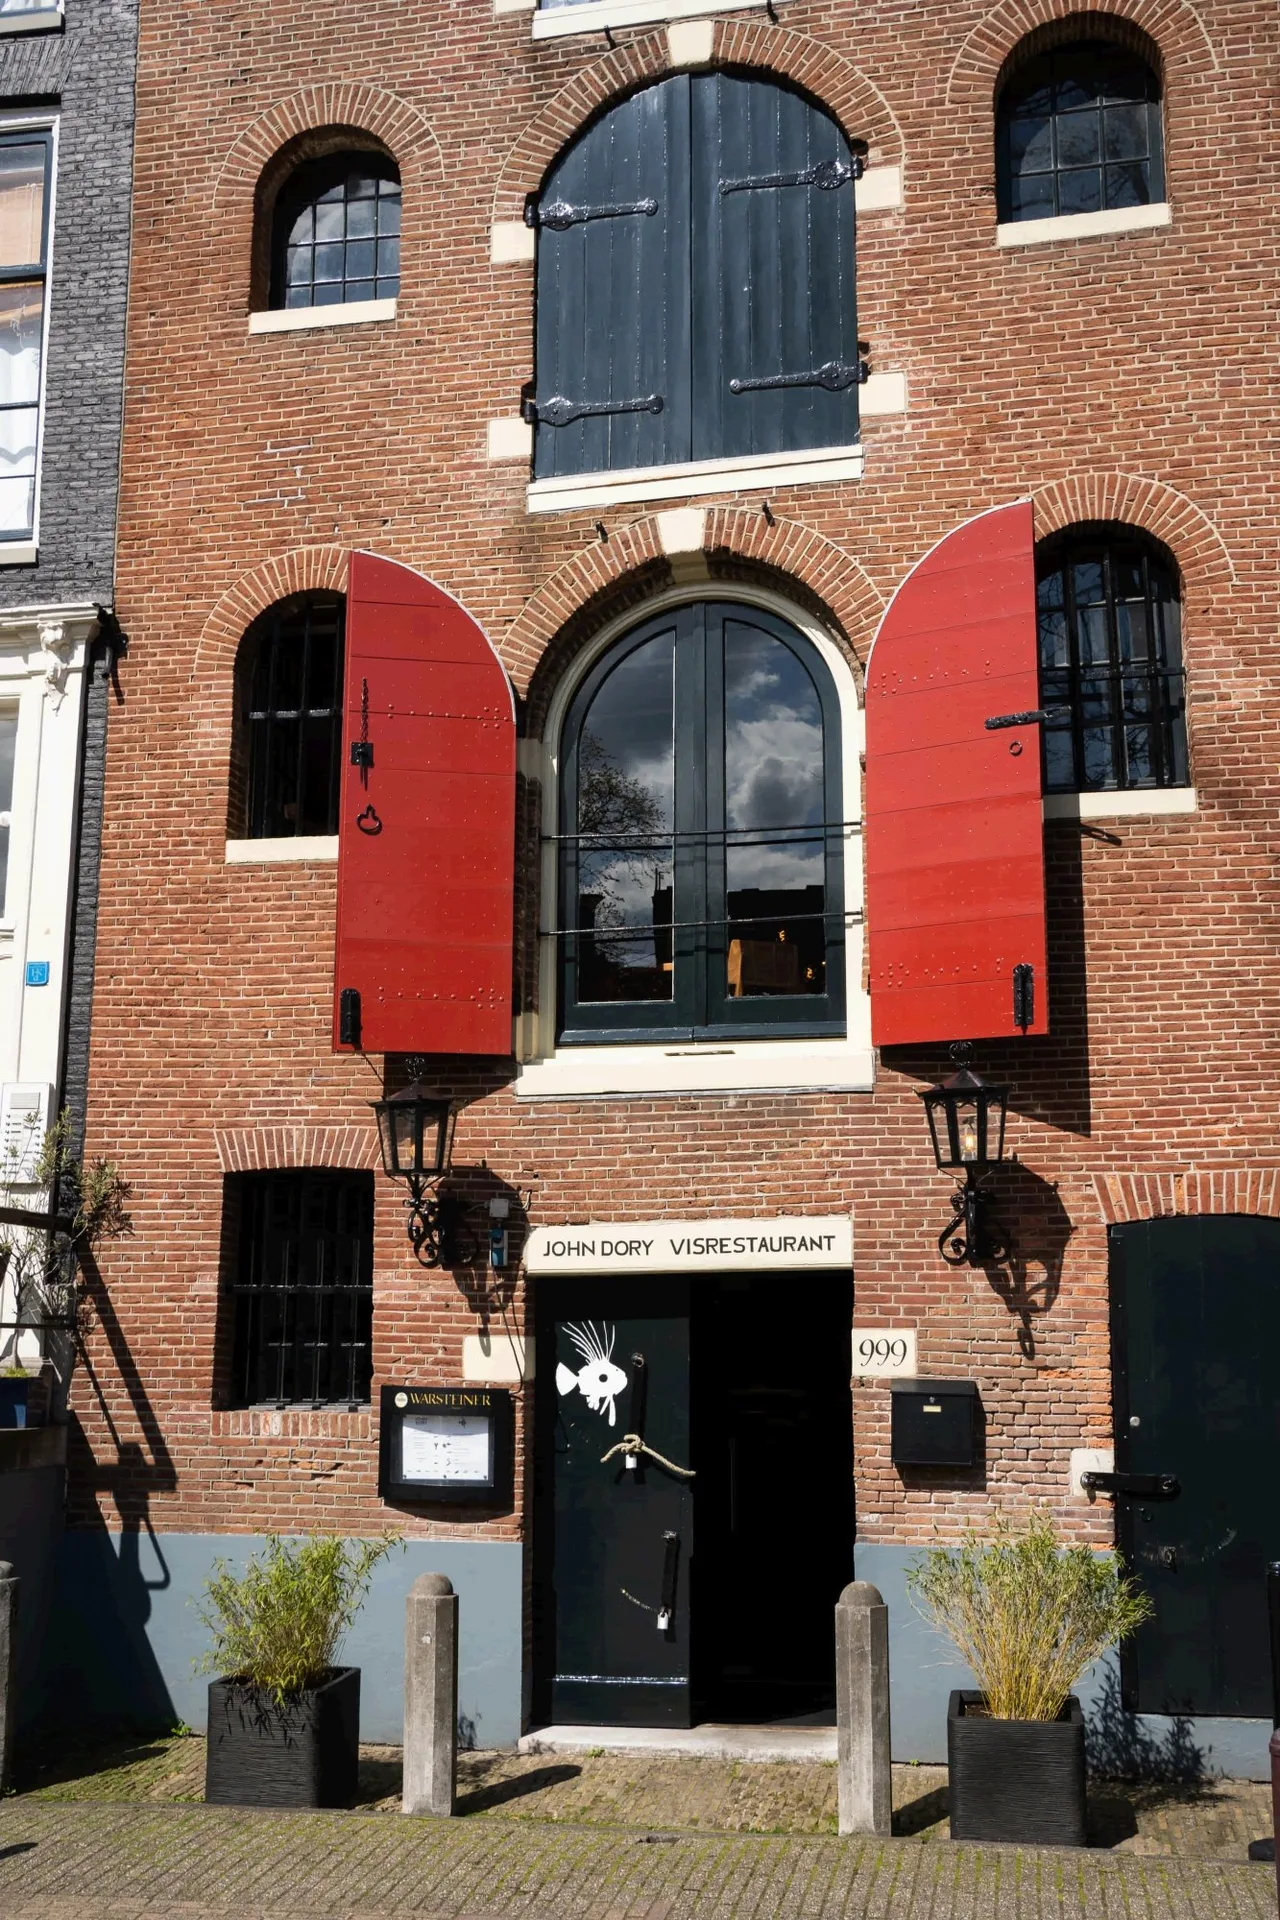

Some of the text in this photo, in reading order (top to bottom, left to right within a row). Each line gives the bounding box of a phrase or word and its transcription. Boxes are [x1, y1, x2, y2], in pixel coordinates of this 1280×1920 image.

[543, 1235, 836, 1257] JOHN DORY VISRESTAURANT
[859, 1338, 908, 1367] 999
[410, 1392, 491, 1406] WARSTEINER
